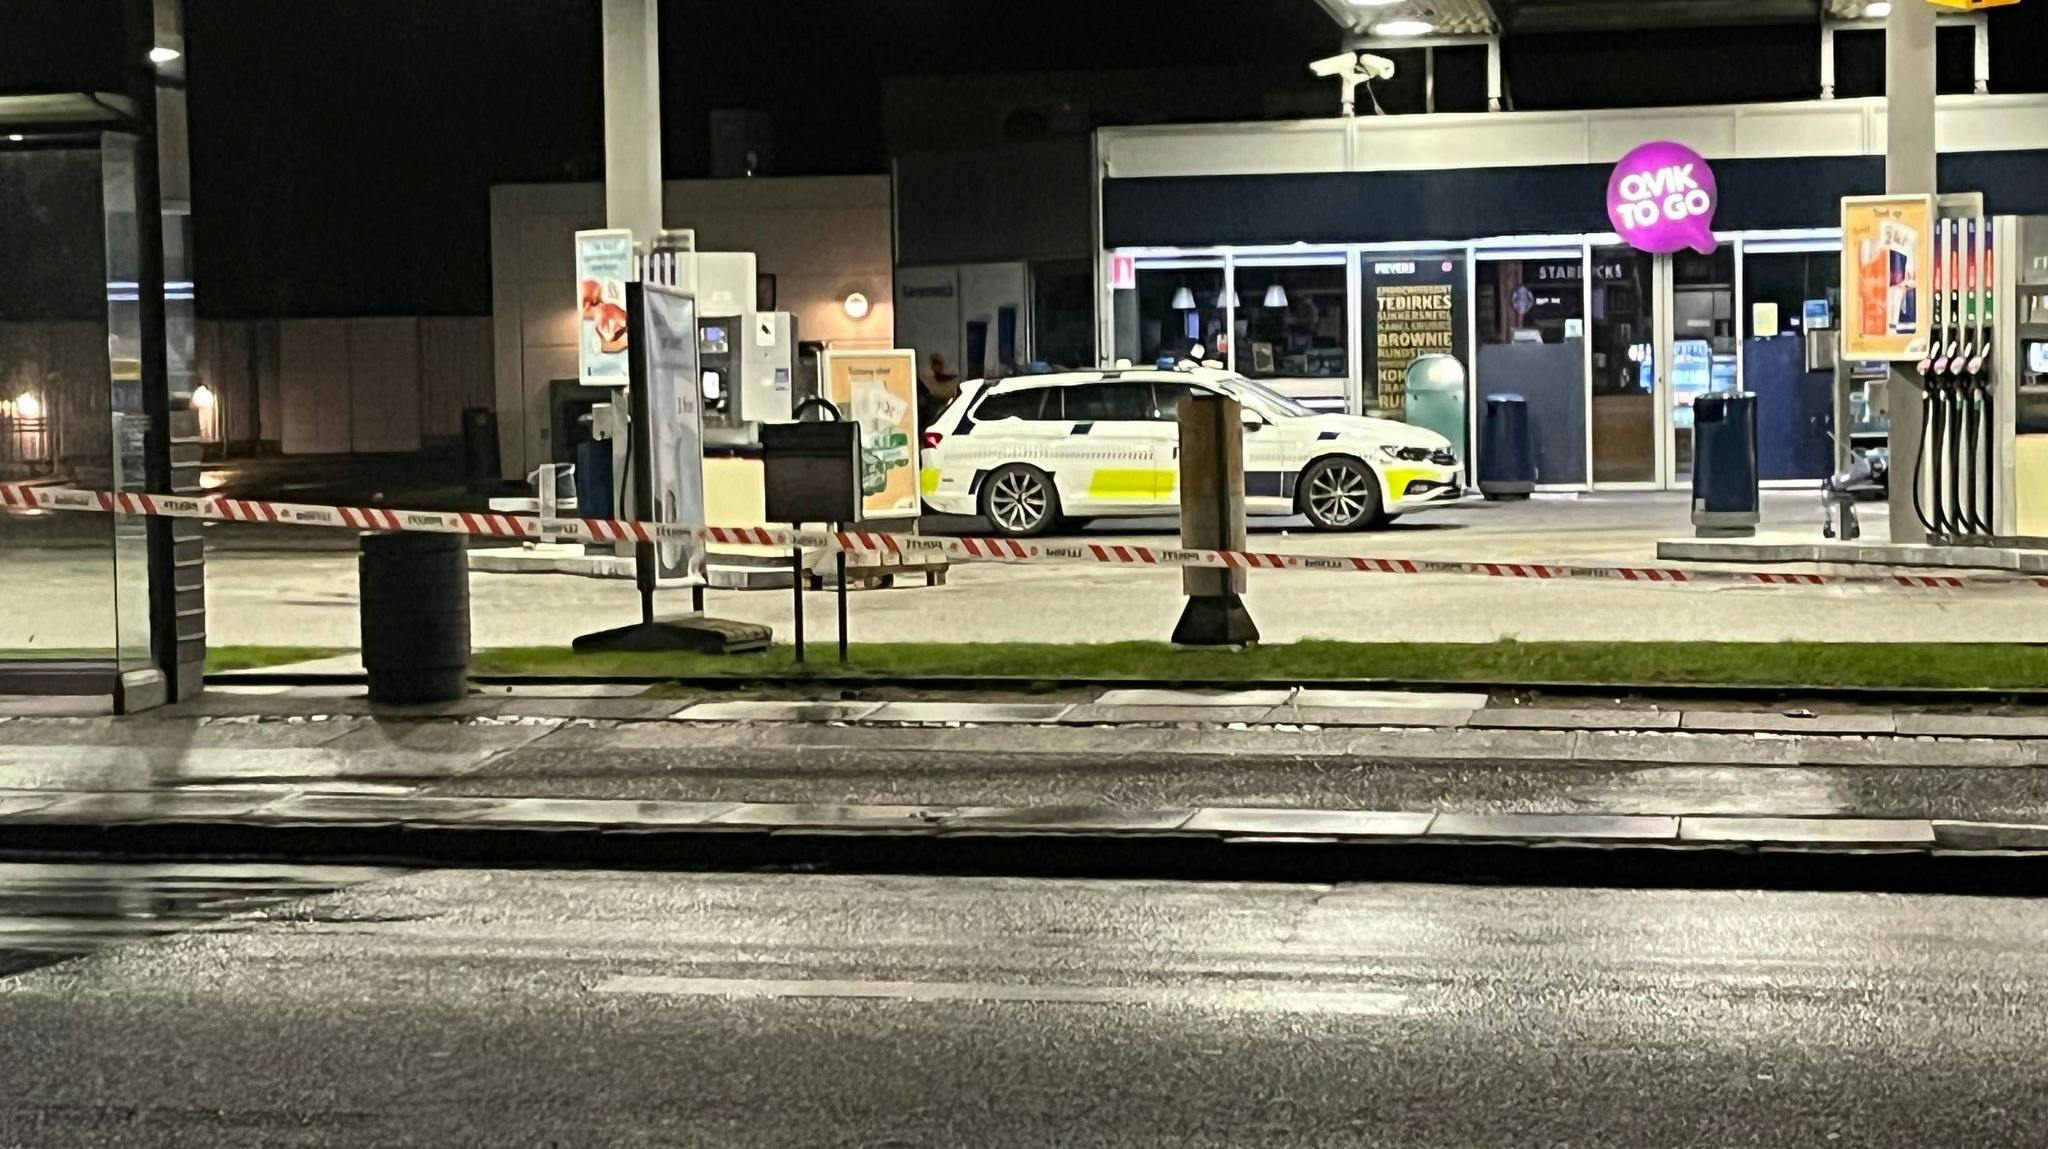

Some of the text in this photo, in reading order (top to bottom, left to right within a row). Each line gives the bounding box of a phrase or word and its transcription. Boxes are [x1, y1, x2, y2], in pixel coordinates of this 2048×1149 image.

[1619, 163, 1698, 200] QVIK
[1616, 189, 1710, 230] TO GO
[1539, 264, 1622, 279] STARBCKS
[1377, 294, 1452, 311] TEBIRKES
[1377, 331, 1453, 348] BROWNIE
